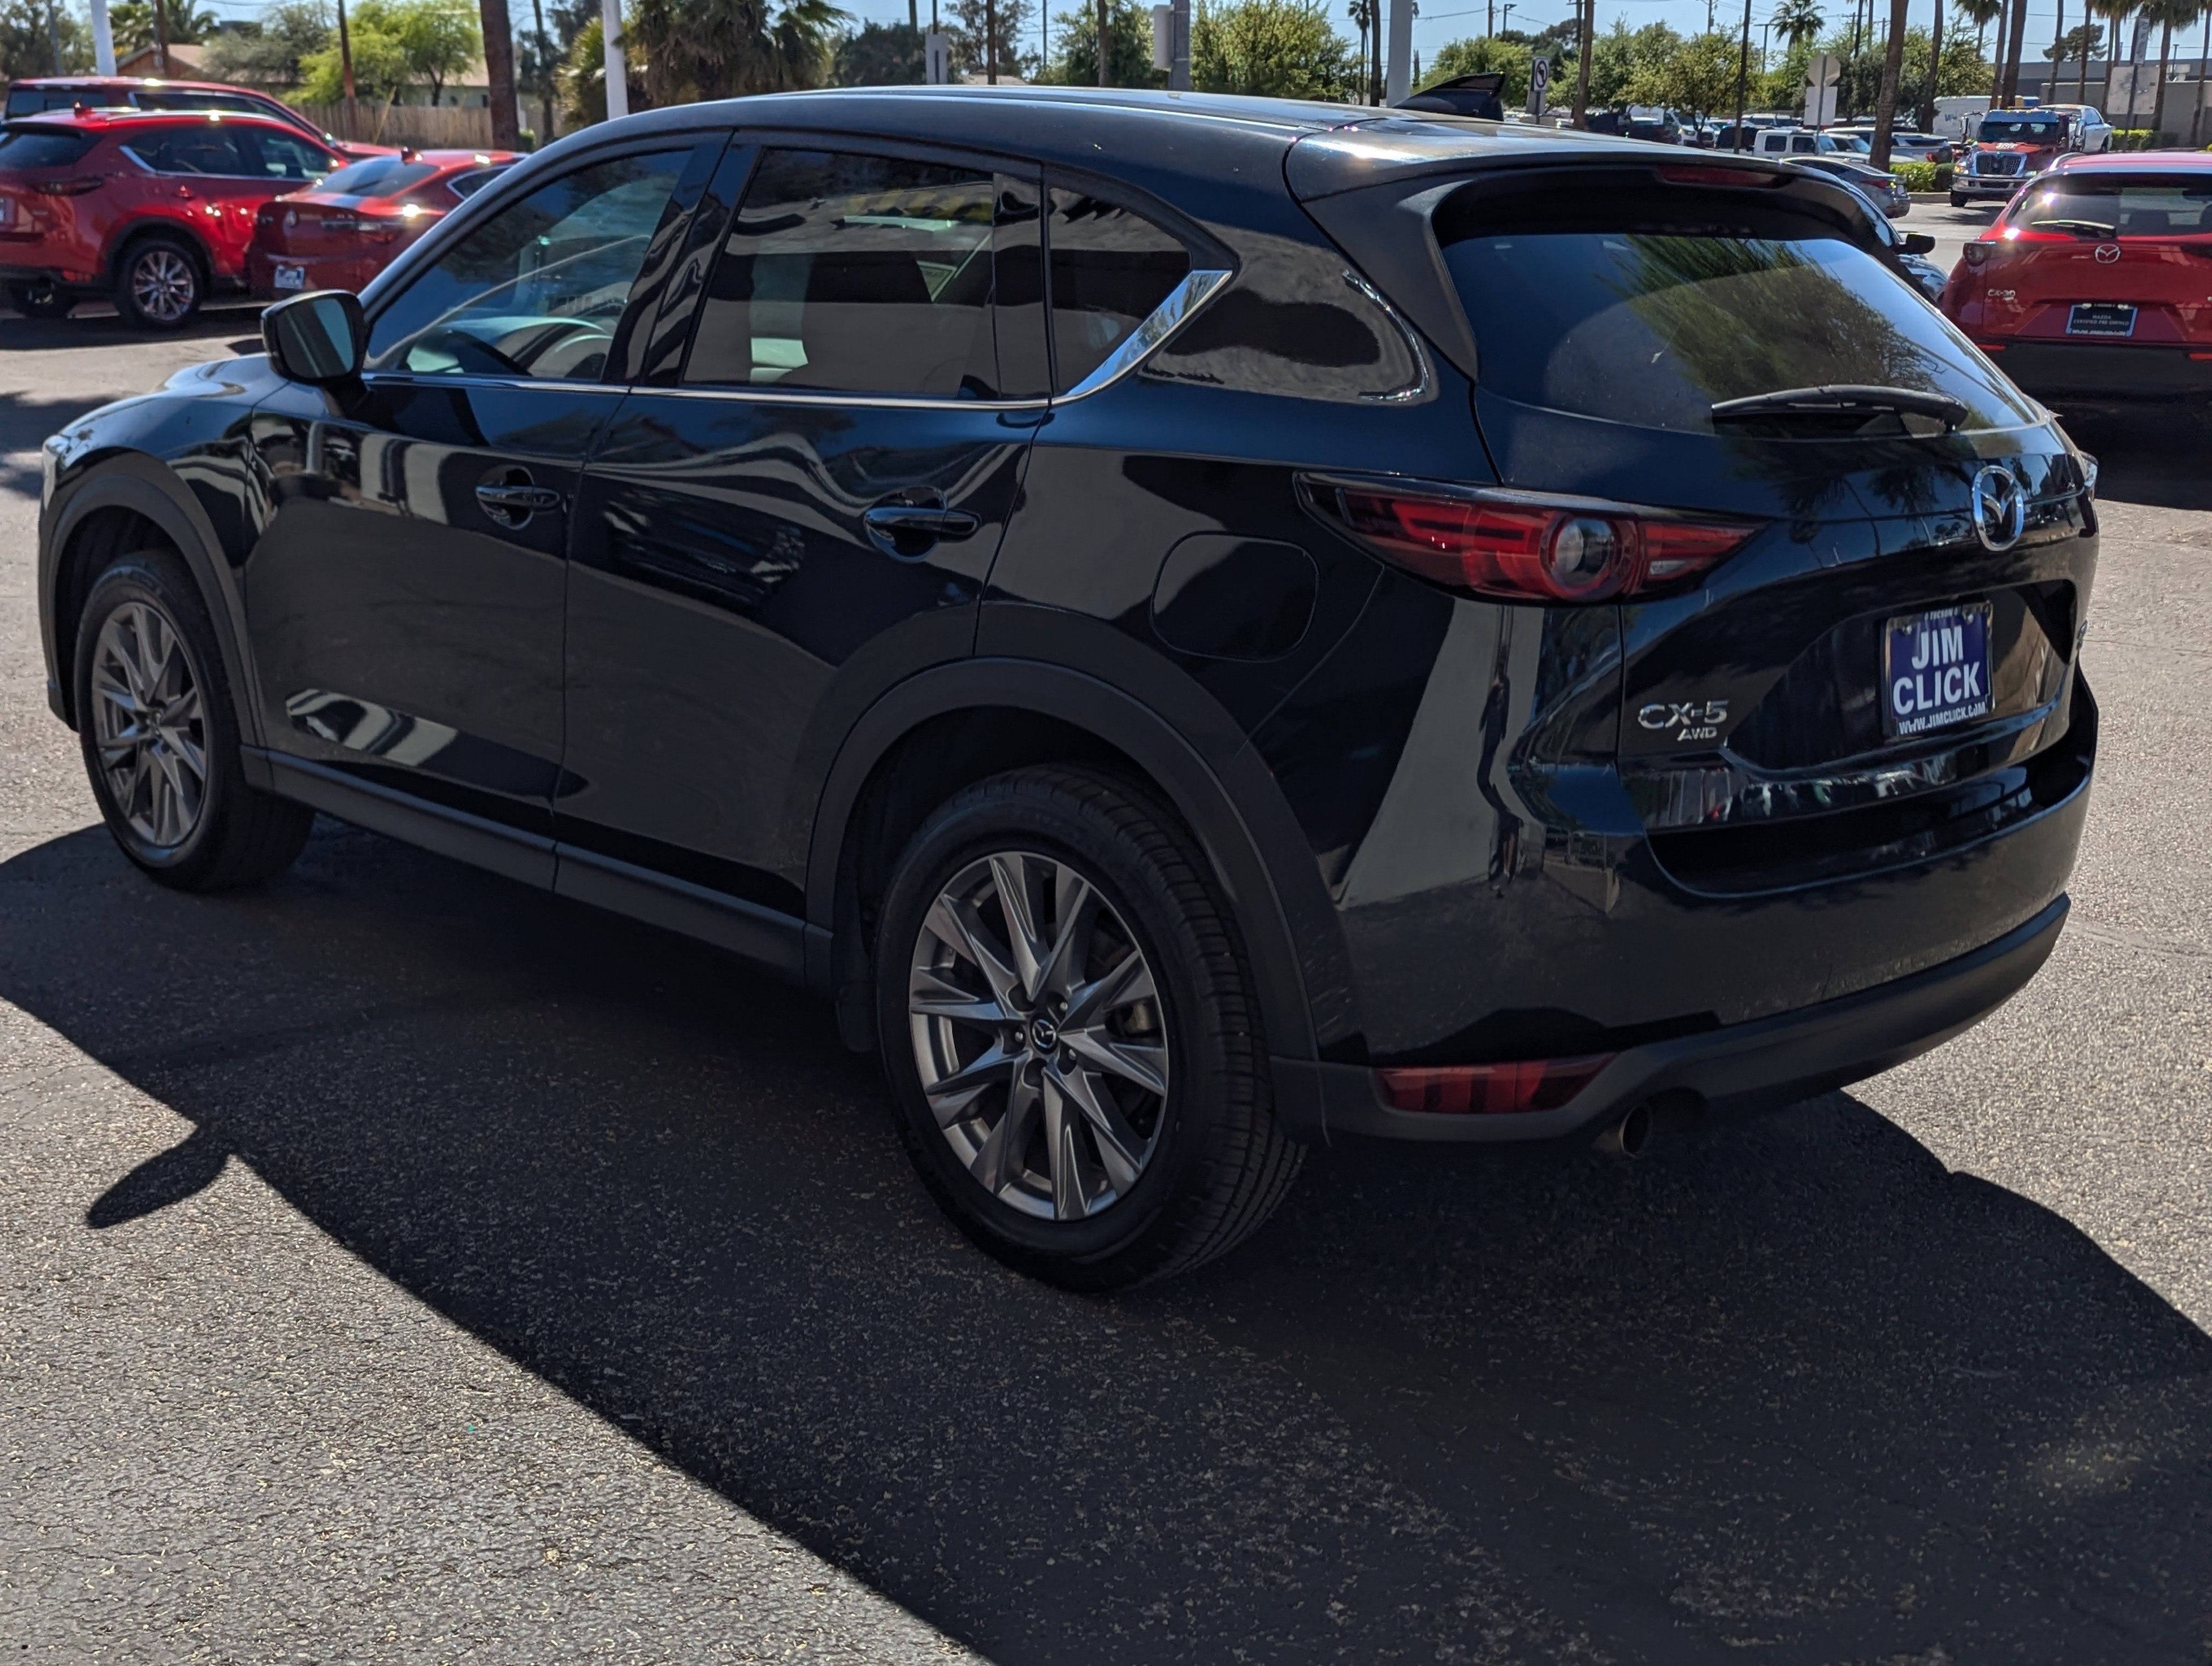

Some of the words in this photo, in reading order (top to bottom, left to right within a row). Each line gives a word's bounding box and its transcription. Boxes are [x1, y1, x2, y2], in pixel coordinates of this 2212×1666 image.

[1911, 625, 1964, 669] JIM
[1893, 661, 1981, 715] CLICK
[1638, 699, 1729, 729] CX-5
[1677, 727, 1717, 741] AWD
